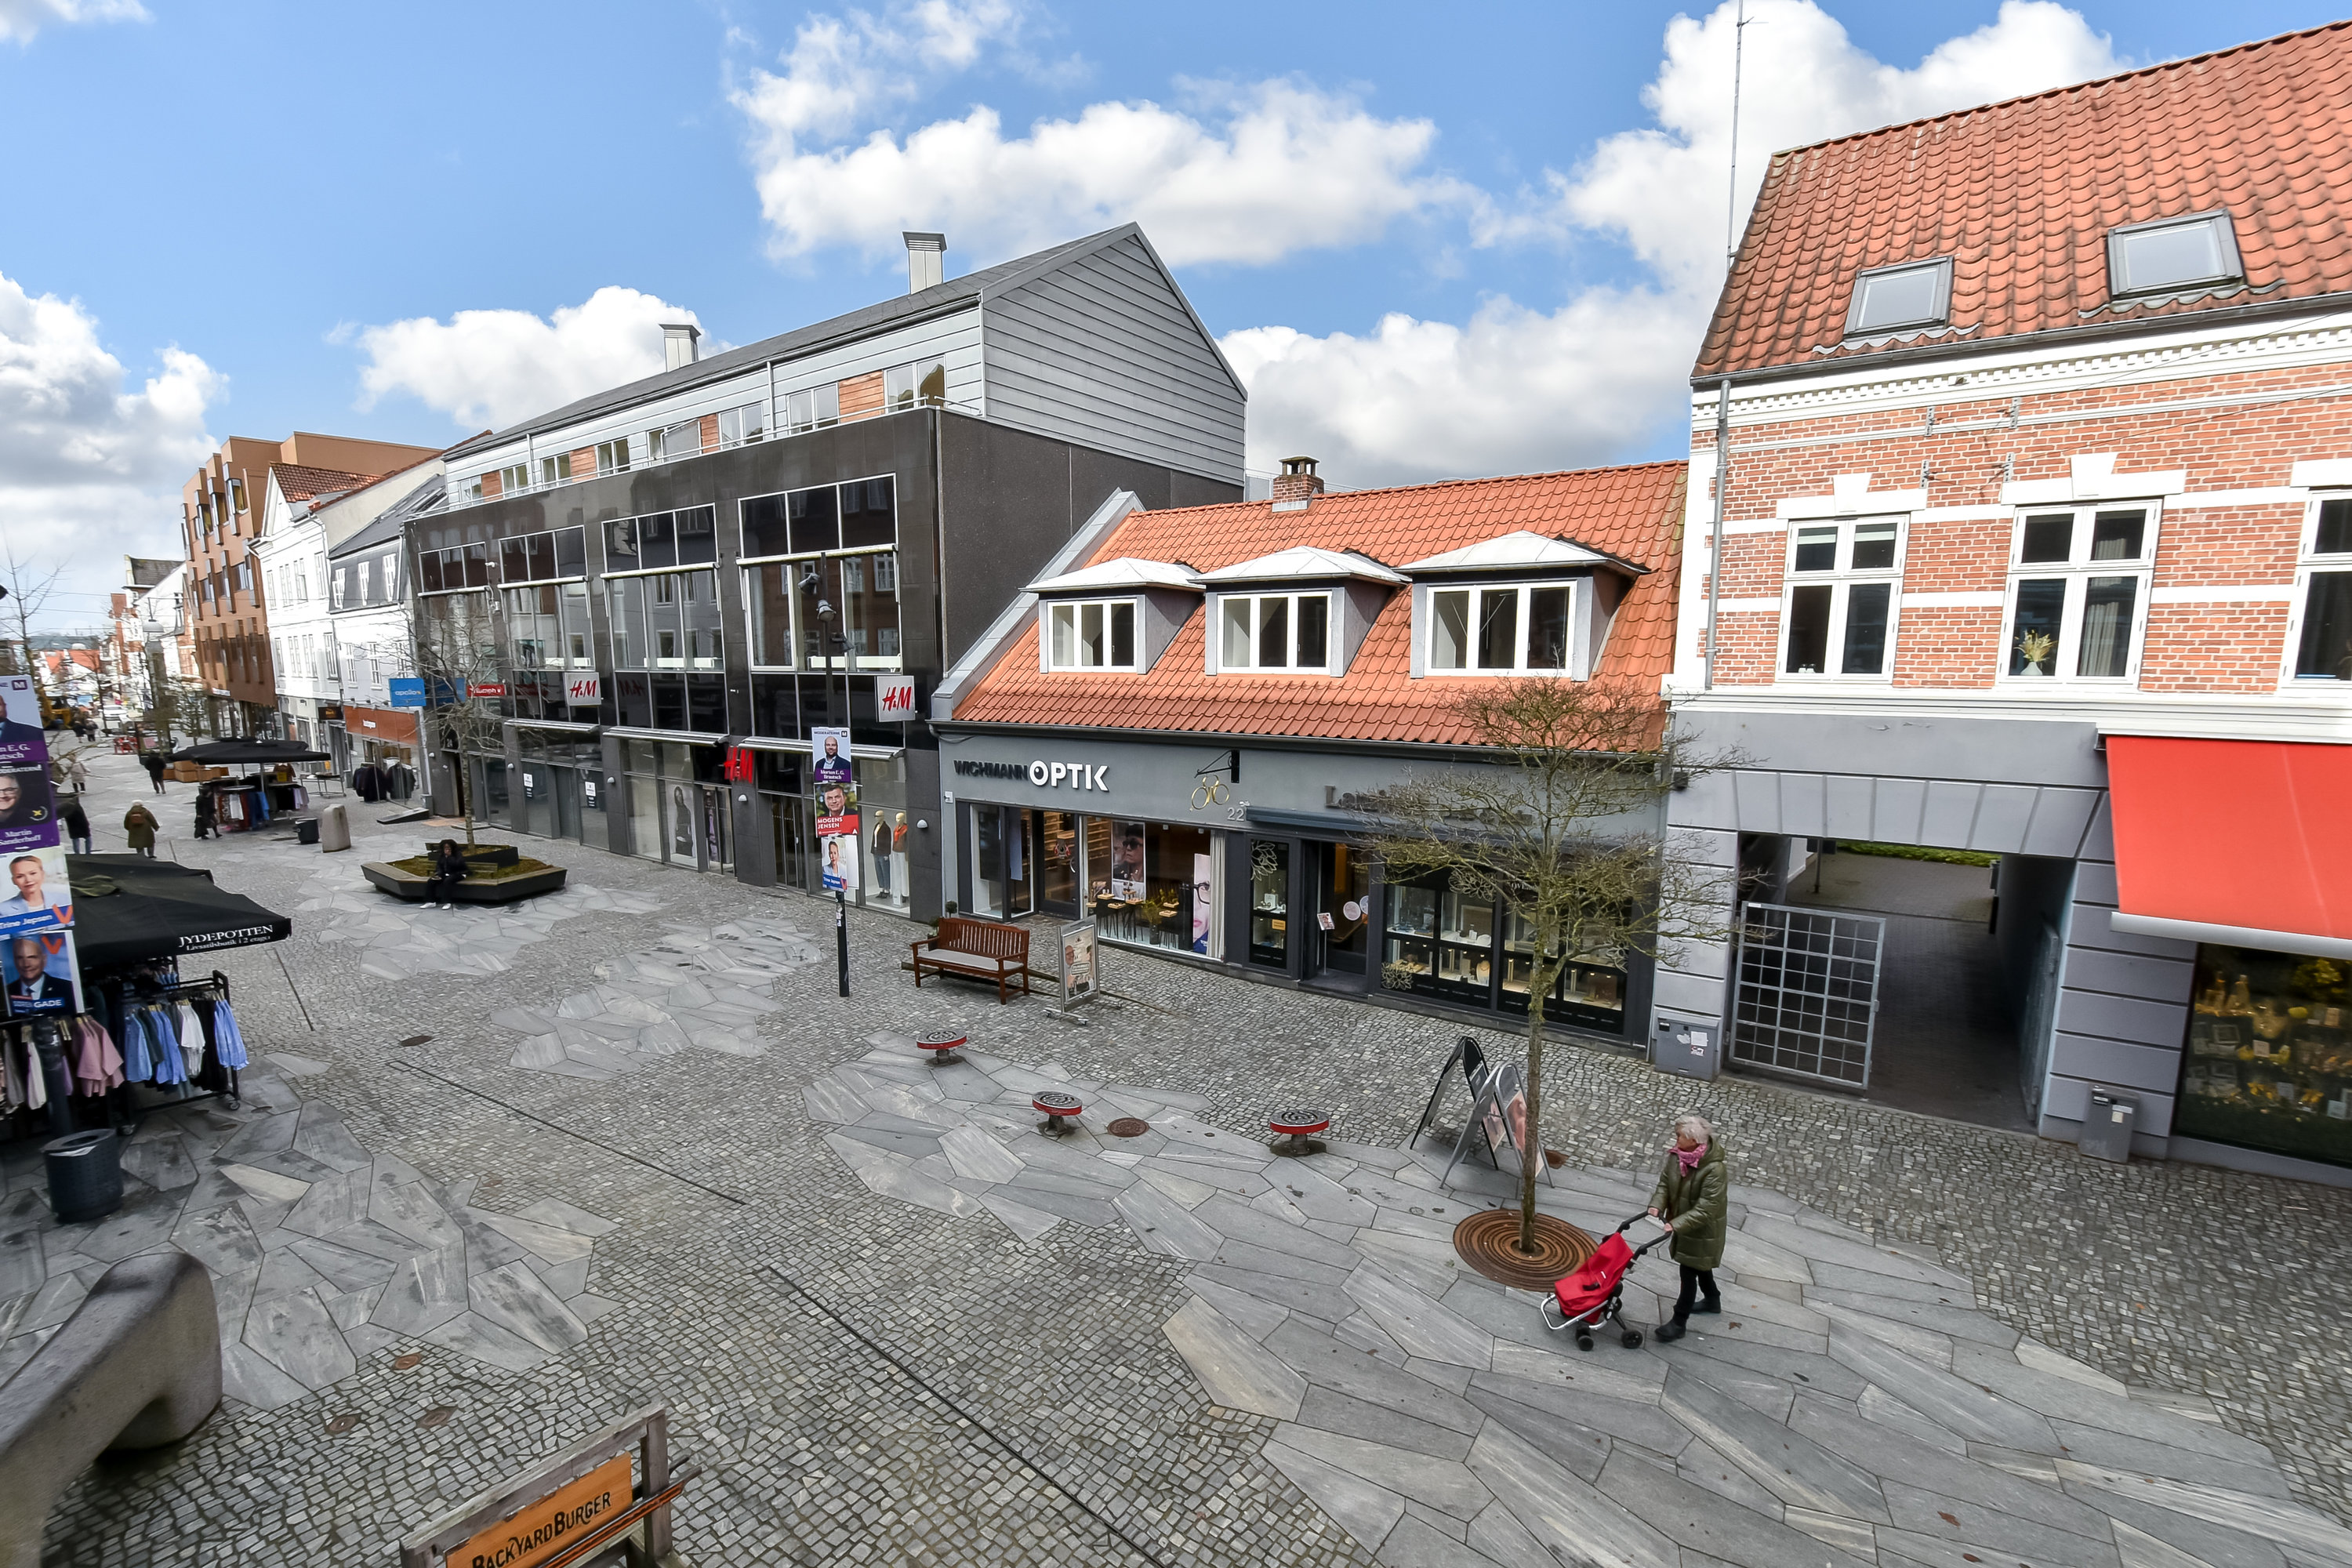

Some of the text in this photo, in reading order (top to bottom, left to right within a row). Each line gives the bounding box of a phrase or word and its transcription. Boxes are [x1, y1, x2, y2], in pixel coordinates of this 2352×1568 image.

[569, 680, 597, 698] H&M
[882, 686, 912, 712] H&M
[953, 759, 1109, 792] WICHMANN OPTIK
[1227, 808, 1244, 822] 22
[179, 925, 273, 947] JYDEPOTTEN
[34, 999, 62, 1008] GADE
